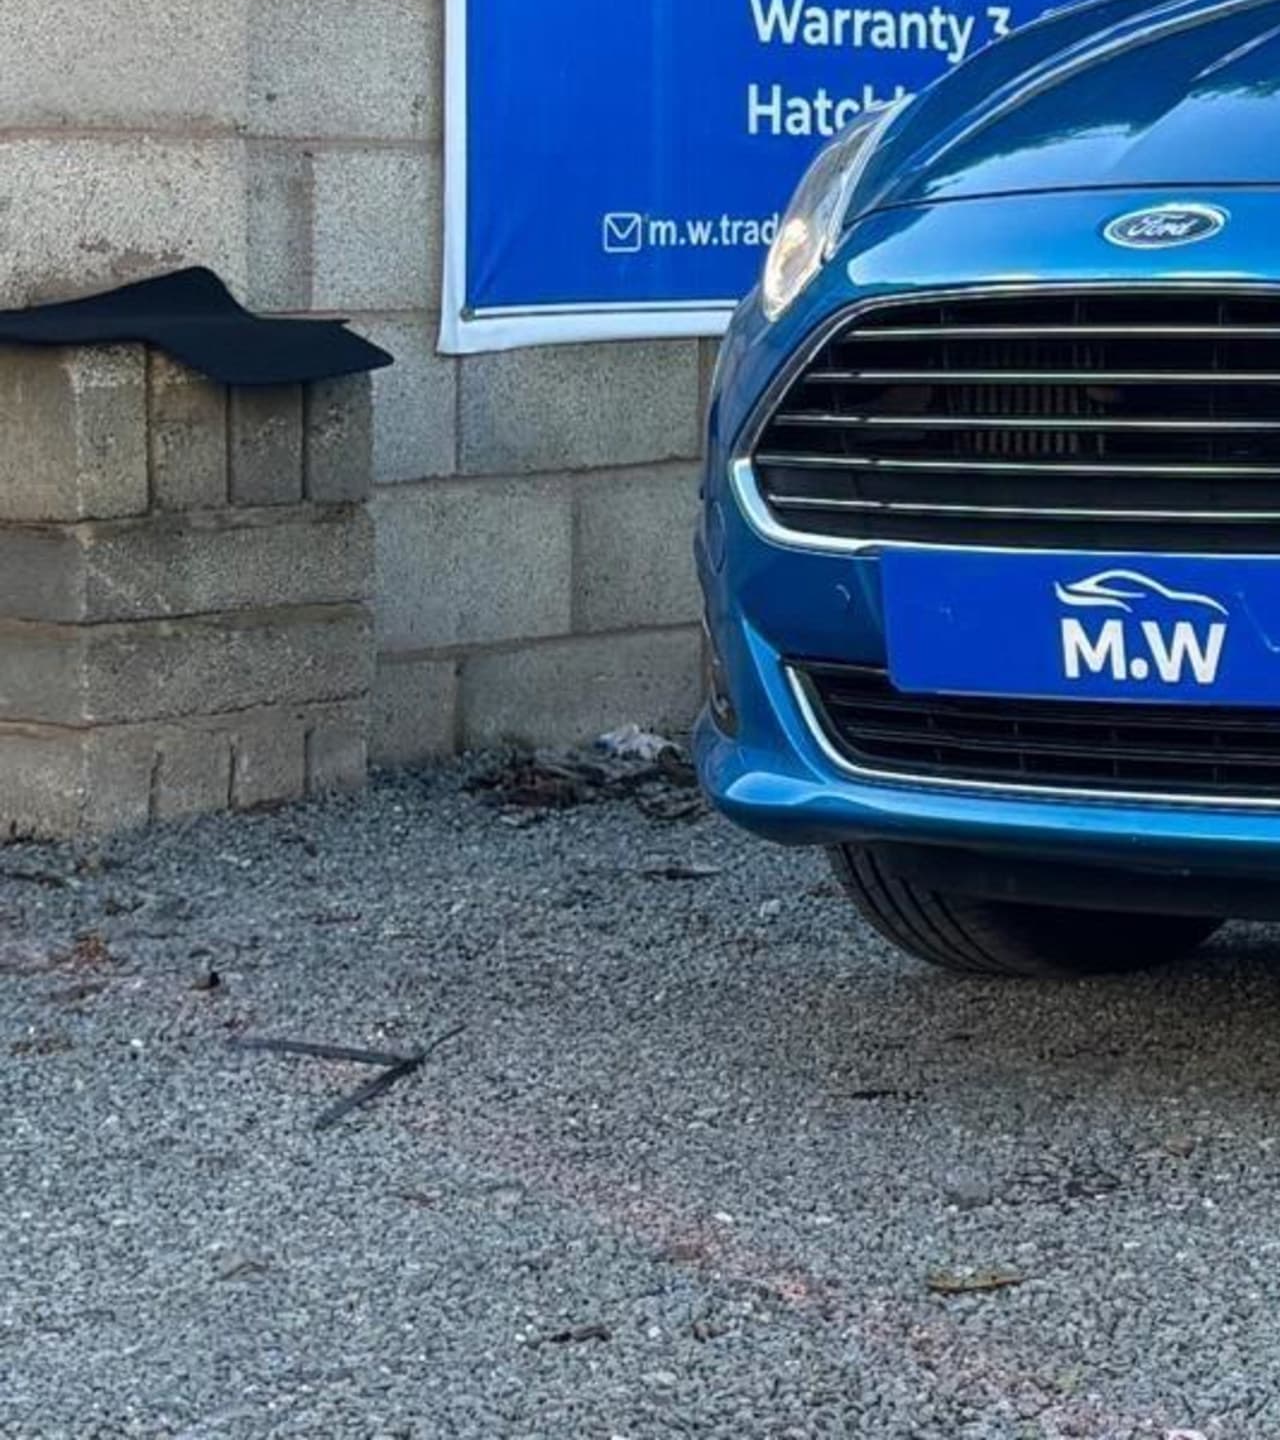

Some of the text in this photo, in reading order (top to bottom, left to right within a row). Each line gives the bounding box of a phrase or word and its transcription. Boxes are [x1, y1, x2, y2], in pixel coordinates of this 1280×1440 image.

[748, 82, 905, 136] Hatc
[649, 212, 779, 246] m.w.trad
[1060, 616, 1227, 684] M.W
